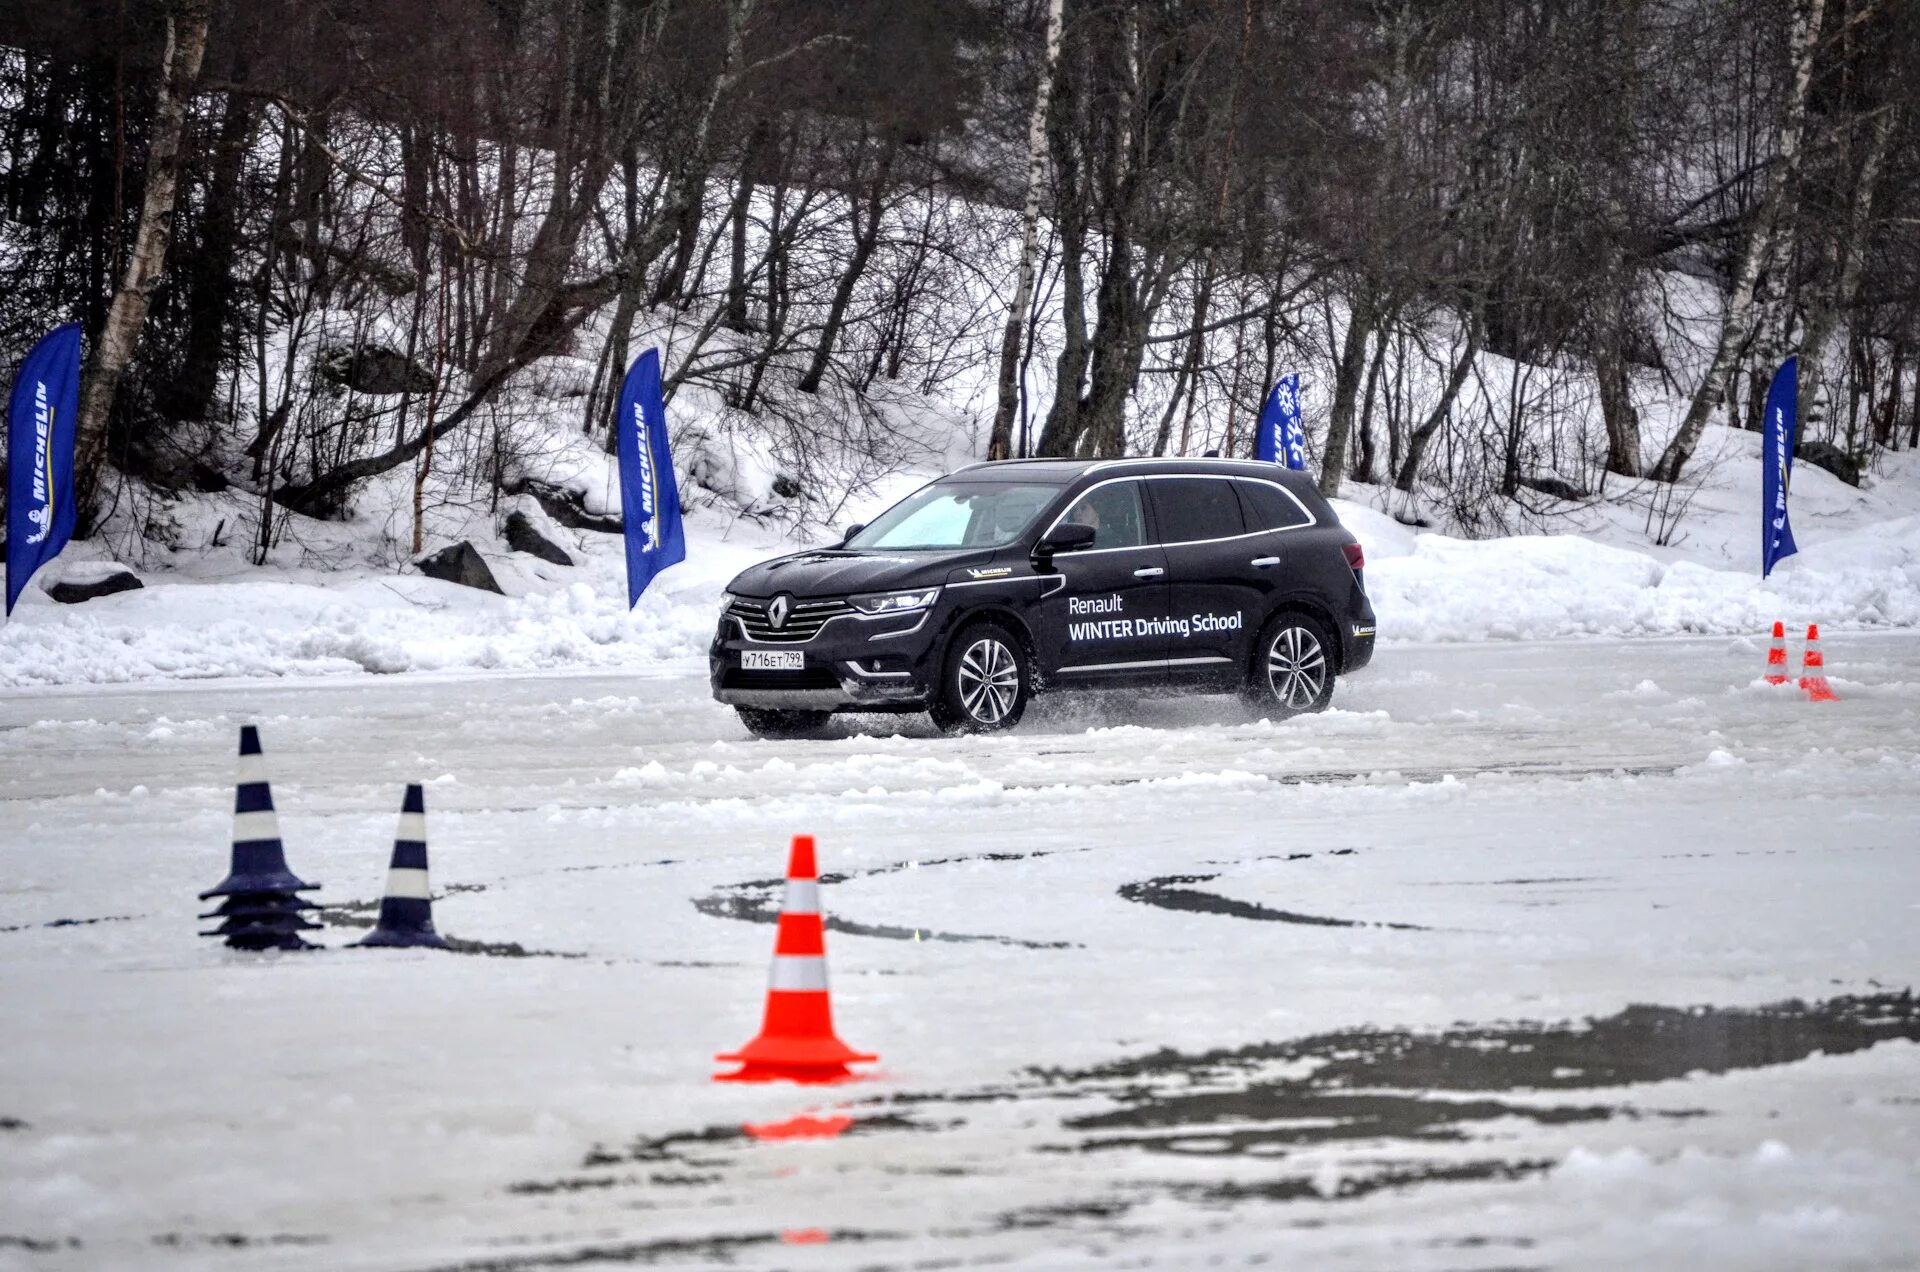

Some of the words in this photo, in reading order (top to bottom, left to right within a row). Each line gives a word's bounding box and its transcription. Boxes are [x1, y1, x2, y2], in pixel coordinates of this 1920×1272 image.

[33, 380, 48, 502] MICHELIN
[634, 402, 654, 514] MICHELIN
[1069, 594, 1123, 615] Renault
[1069, 620, 1133, 641] WINTER
[1135, 616, 1190, 638] Driving
[1191, 611, 1242, 632] School
[784, 652, 801, 664] 799
